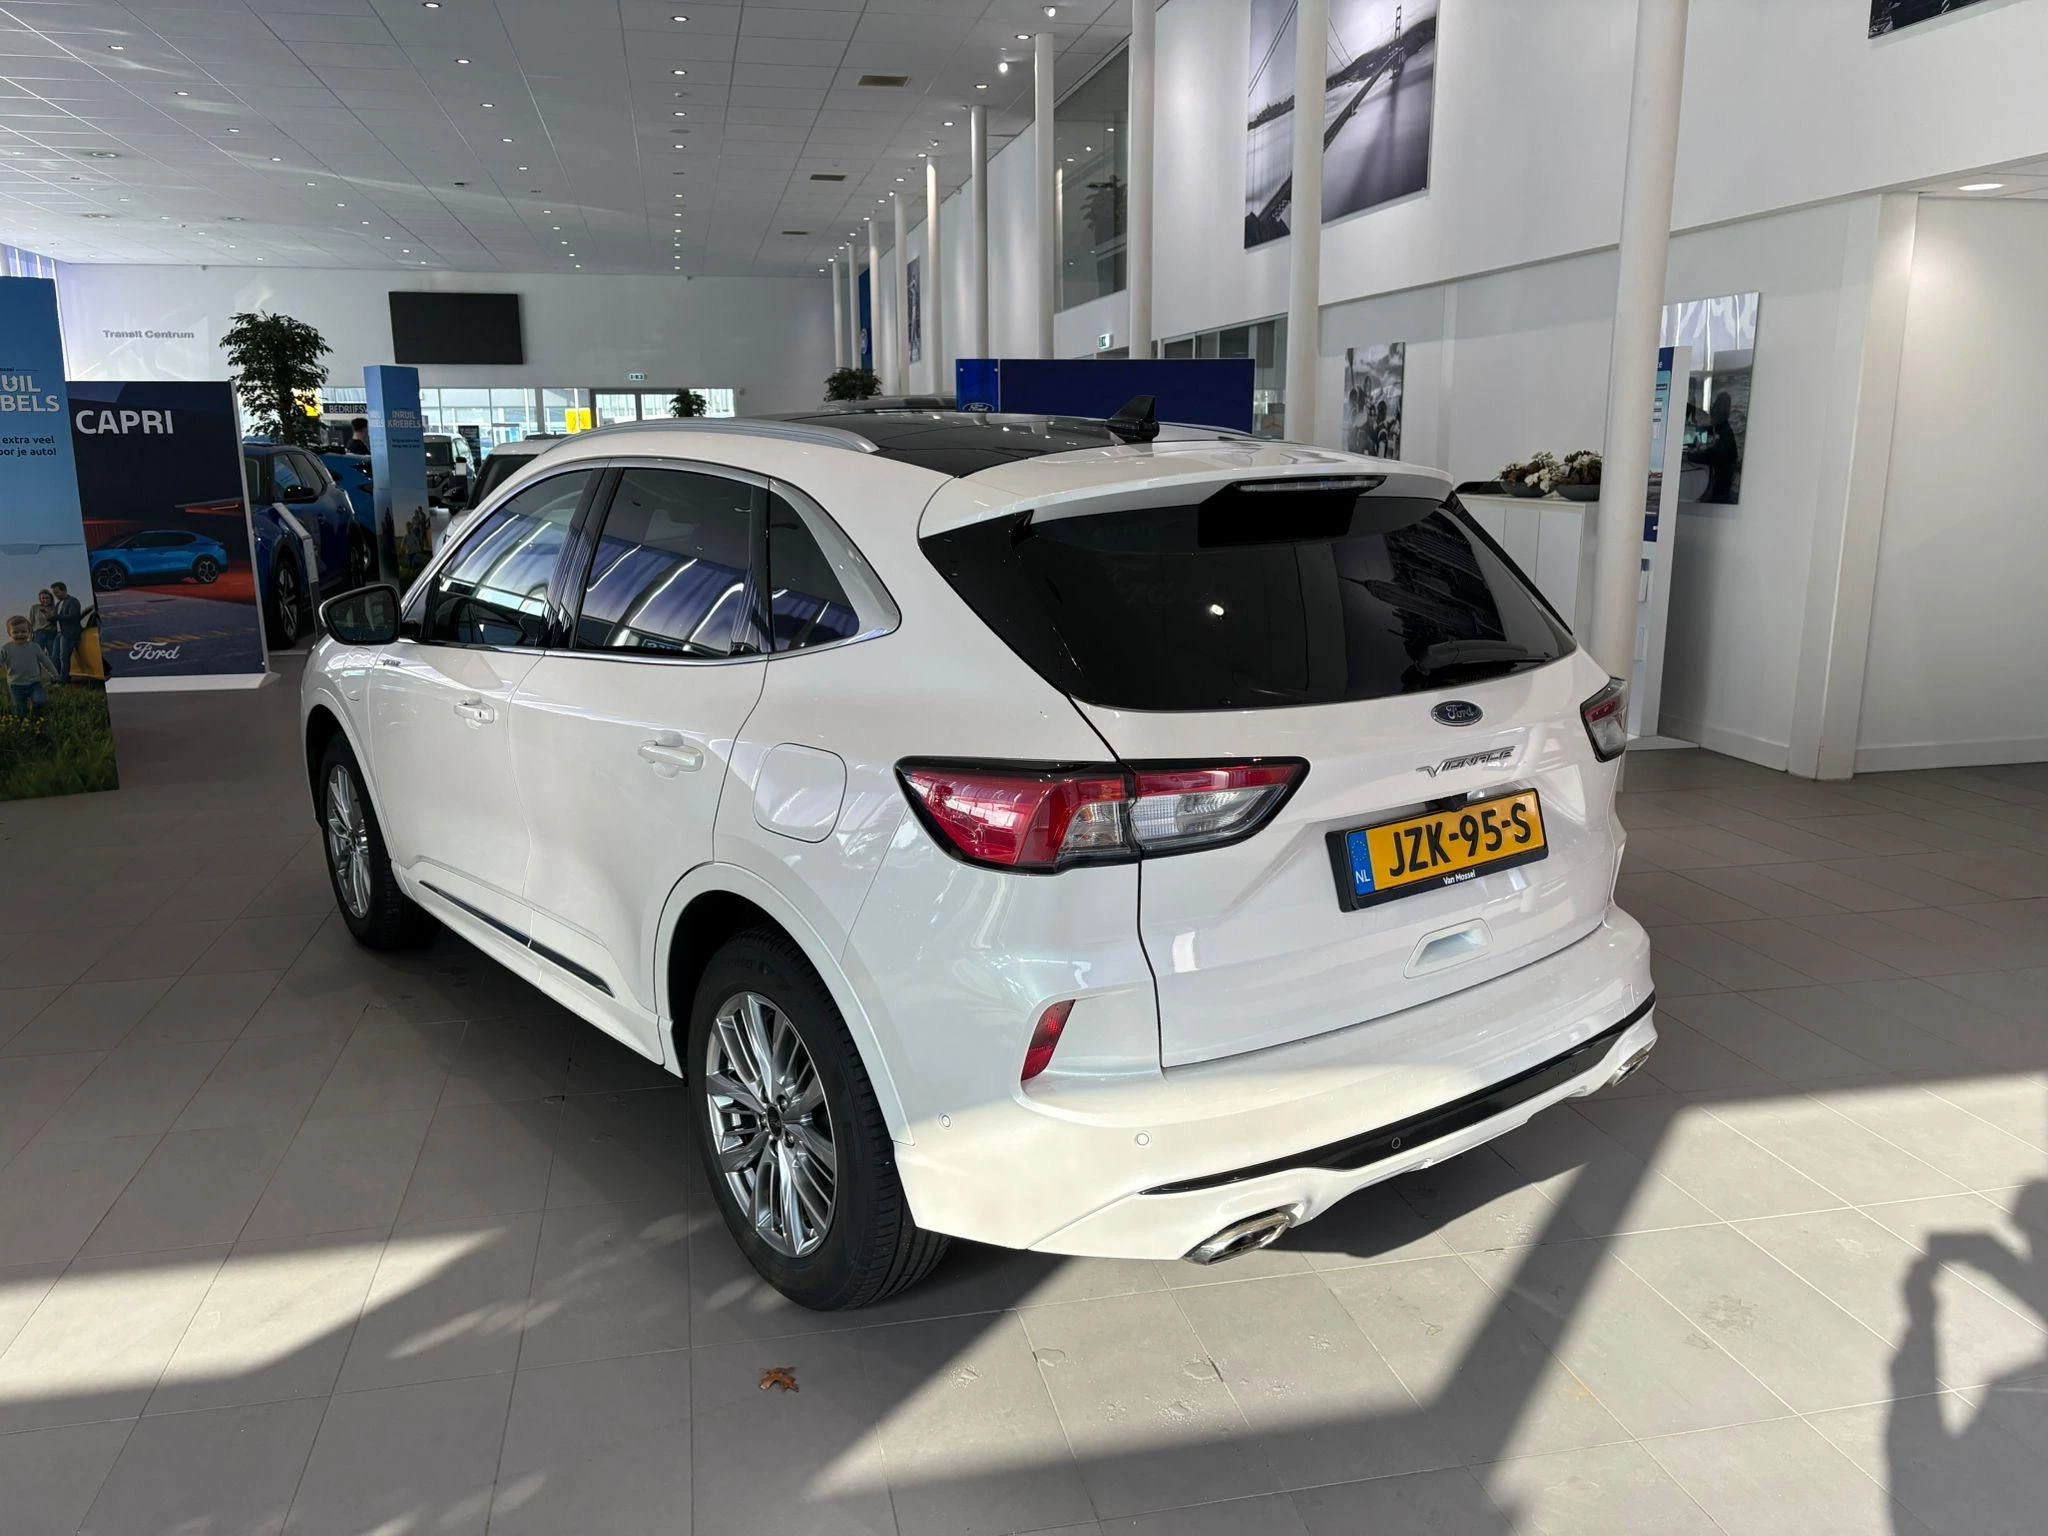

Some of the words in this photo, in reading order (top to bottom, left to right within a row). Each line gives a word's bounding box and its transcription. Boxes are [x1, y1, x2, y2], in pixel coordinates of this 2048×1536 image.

[103, 330, 143, 338] Transit
[145, 330, 194, 339] Centrum
[0, 374, 42, 393] UIL
[76, 409, 174, 435] CAPRI
[2, 436, 30, 444] extra
[33, 435, 55, 444] veel
[17, 447, 27, 457] je
[30, 447, 57, 456] auto!
[129, 641, 180, 660] Ford
[1446, 704, 1474, 720] Ford
[1416, 745, 1515, 778] VIGNALE
[1389, 803, 1532, 877] JZK-95-S
[1355, 869, 1371, 884] NL
[1442, 875, 1455, 886] Van
[1455, 869, 1476, 882] Mossel
